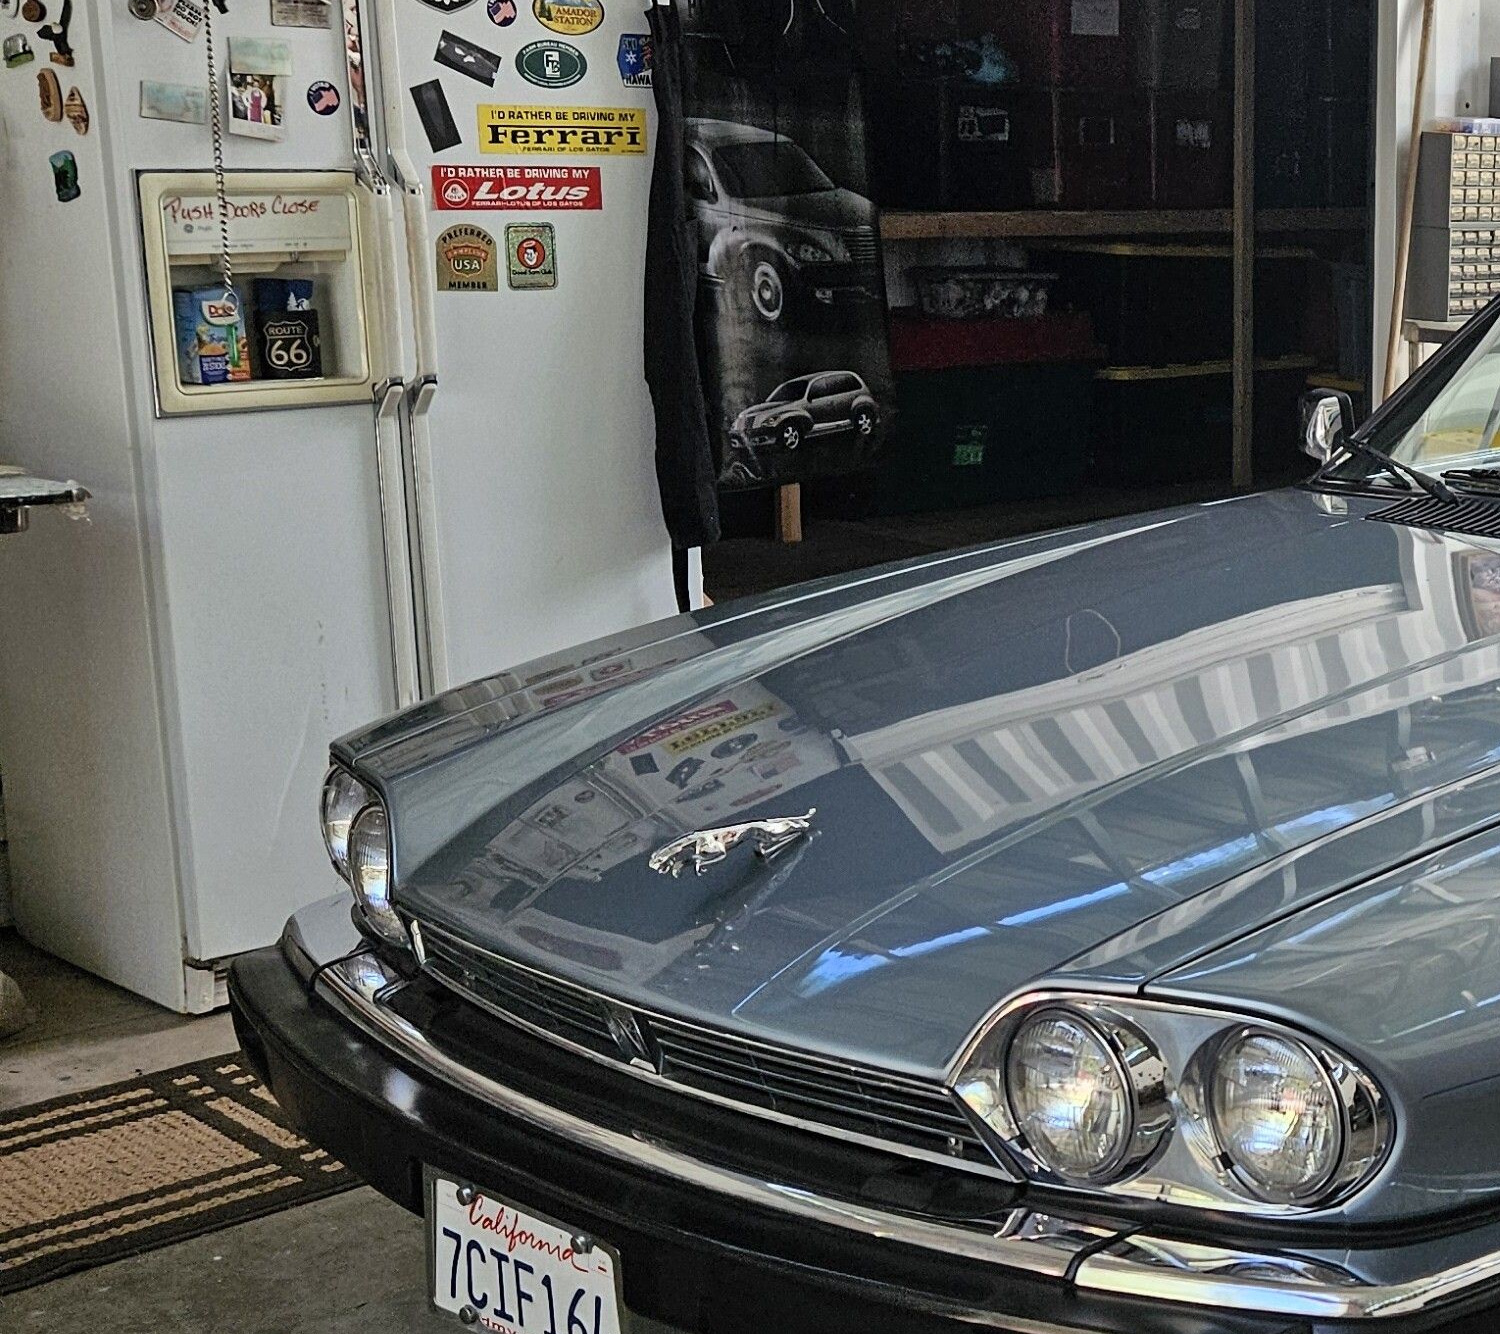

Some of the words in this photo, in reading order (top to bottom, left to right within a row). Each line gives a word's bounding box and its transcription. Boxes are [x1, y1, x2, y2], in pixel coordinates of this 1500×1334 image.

[556, 7, 597, 18] AMADOR
[554, 16, 593, 26] STATION
[625, 74, 652, 85] HAWA
[490, 110, 505, 120] I'D
[508, 110, 551, 121] RATHER
[555, 111, 569, 121] BE
[572, 111, 615, 122] DRIVING
[618, 112, 636, 122] MY
[487, 124, 641, 146] Ferrari
[440, 168, 456, 178] I'D
[458, 168, 504, 178] RATHER
[506, 168, 521, 178] BE
[524, 169, 569, 179] DRIVING
[572, 169, 590, 179] MY
[473, 181, 590, 200] Lotus
[164, 197, 213, 223] PUSH
[222, 200, 267, 220] DOORS
[271, 195, 320, 214] CLOSE
[441, 227, 493, 247] PREFERRED
[454, 259, 480, 270] USA
[448, 281, 487, 290] MEMBER
[268, 326, 303, 336] ROUTE
[270, 339, 308, 365] 66
[469, 1194, 588, 1273] California
